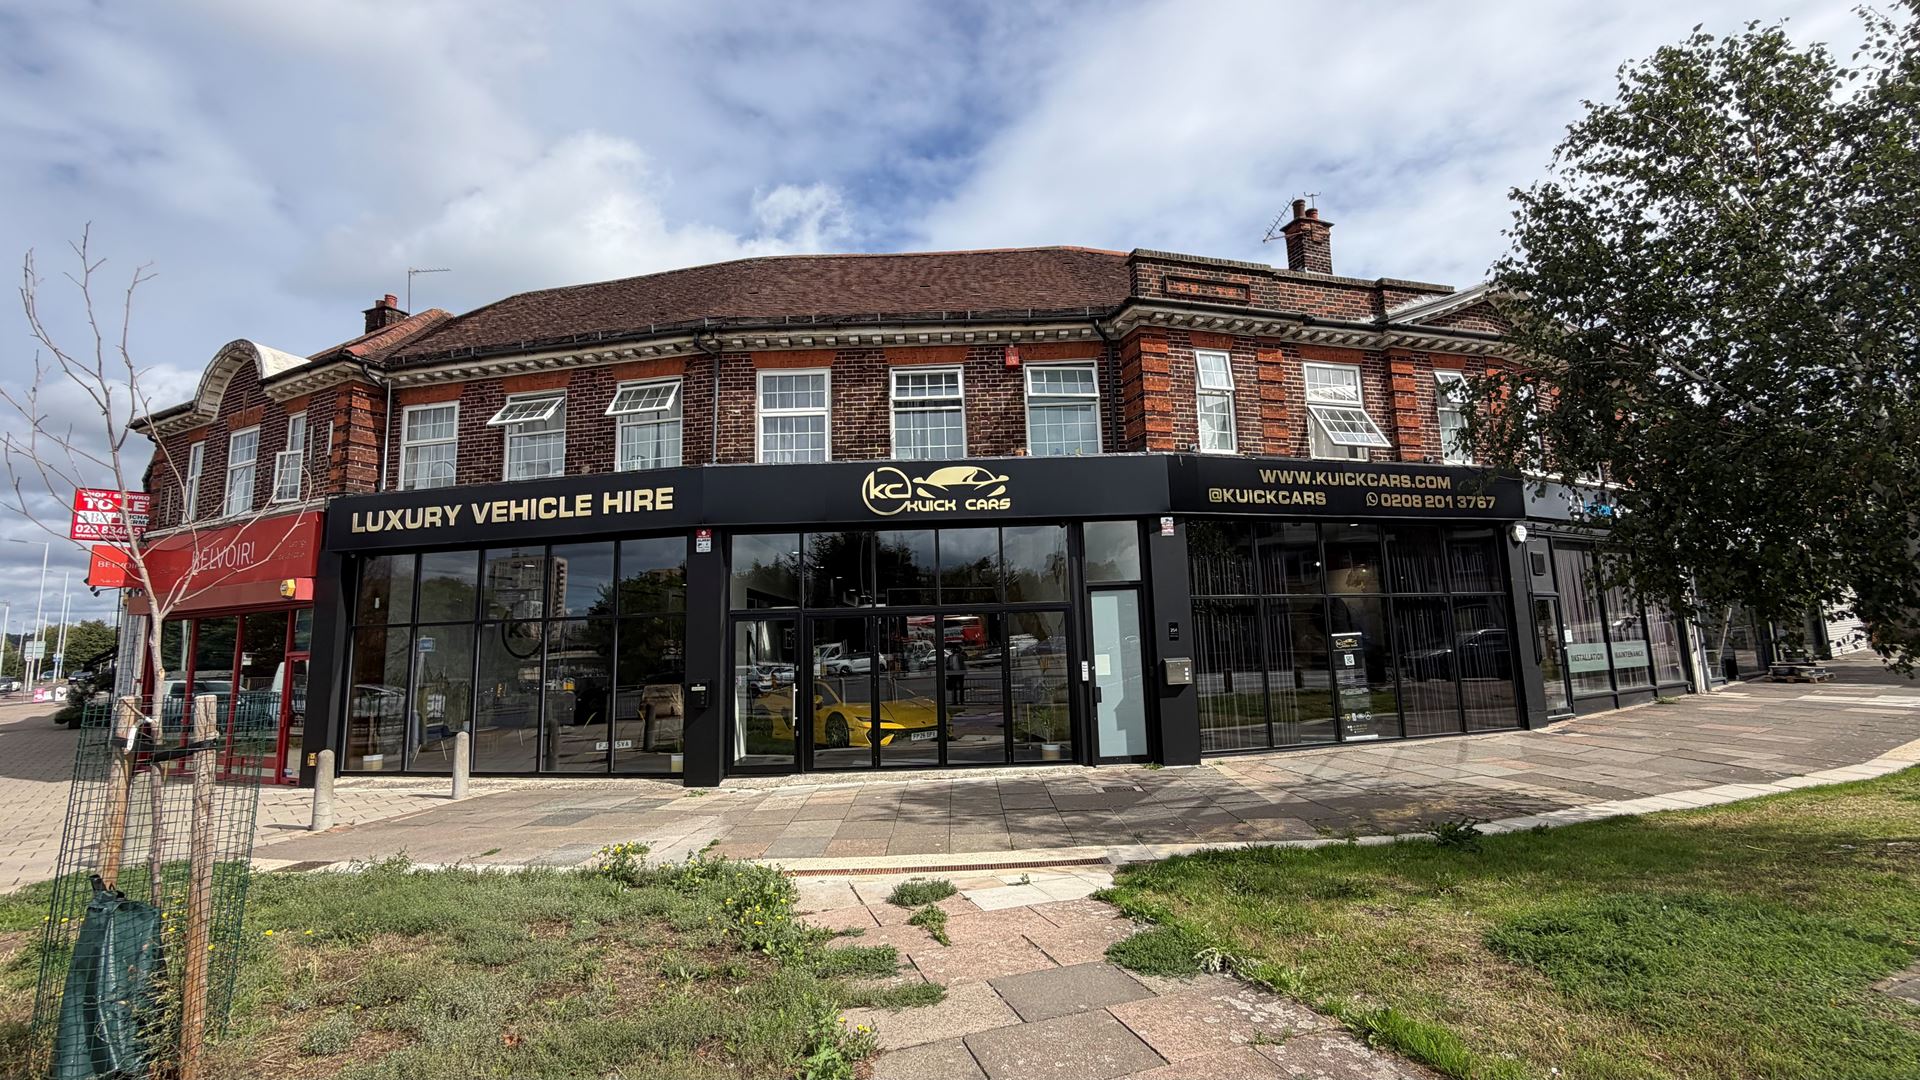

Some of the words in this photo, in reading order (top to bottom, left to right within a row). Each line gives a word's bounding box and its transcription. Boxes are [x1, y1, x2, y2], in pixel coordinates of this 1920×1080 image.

[1259, 469, 1451, 489] WWW.KUICKCARS.COM
[83, 497, 114, 510] TO
[906, 499, 957, 512] KUICK
[965, 497, 1012, 511] CARS
[1208, 487, 1327, 506] @KUICKCARS
[1381, 493, 1422, 508] 0208
[1424, 495, 1454, 509] 201
[1457, 495, 1496, 509] 3767
[351, 504, 463, 533] LUXURY
[471, 493, 593, 525] VEHICLE
[602, 486, 674, 515] HIRE
